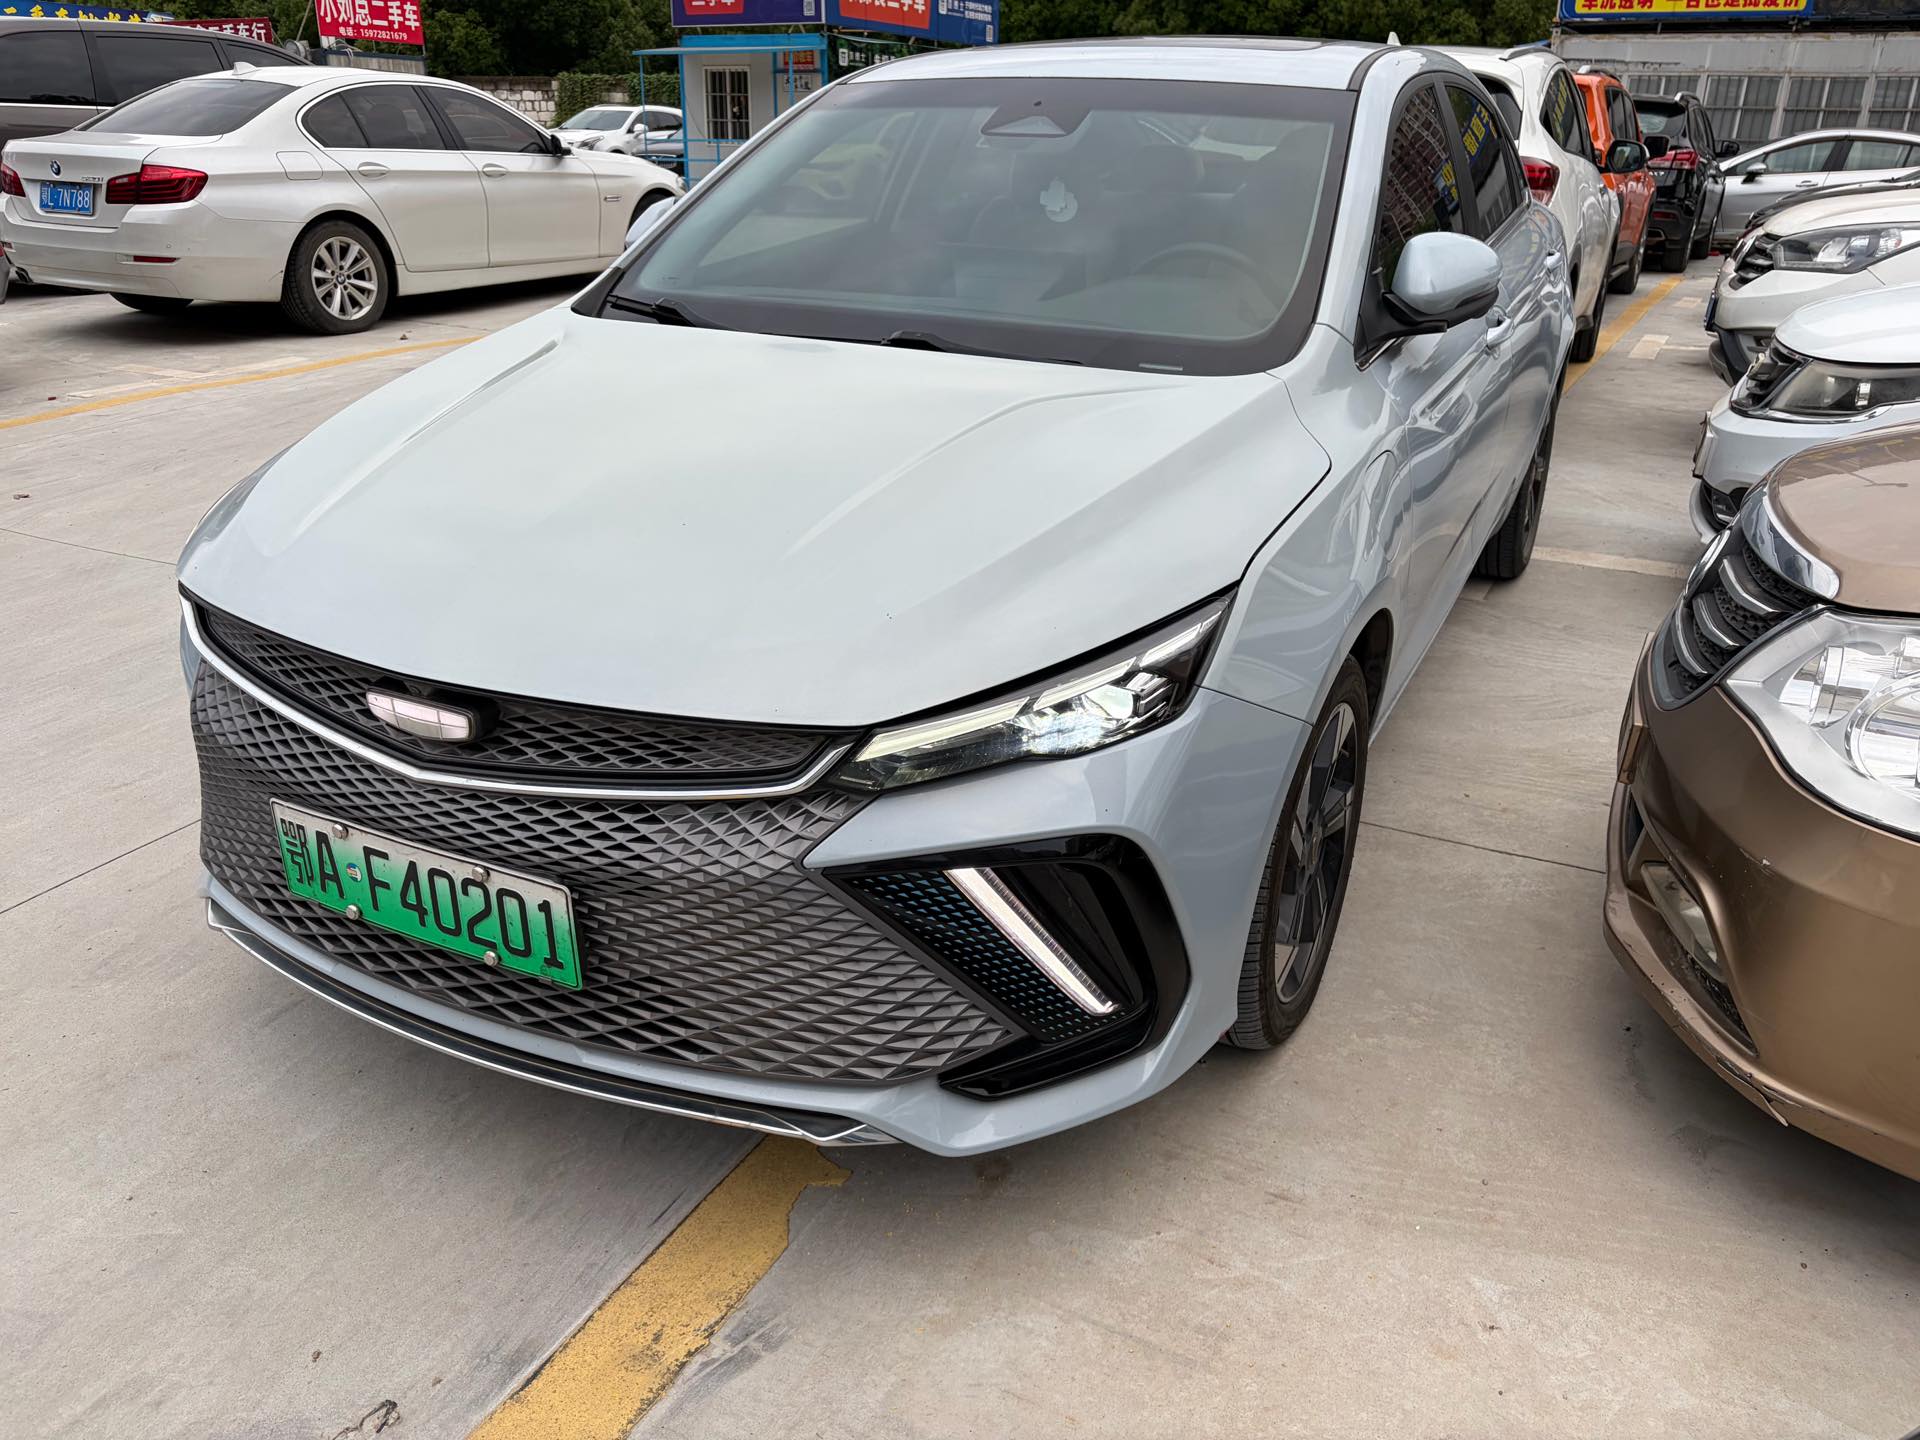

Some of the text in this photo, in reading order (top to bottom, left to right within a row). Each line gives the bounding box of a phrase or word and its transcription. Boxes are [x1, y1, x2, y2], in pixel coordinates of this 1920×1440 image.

[319, 0, 420, 31] 小刘总二手车
